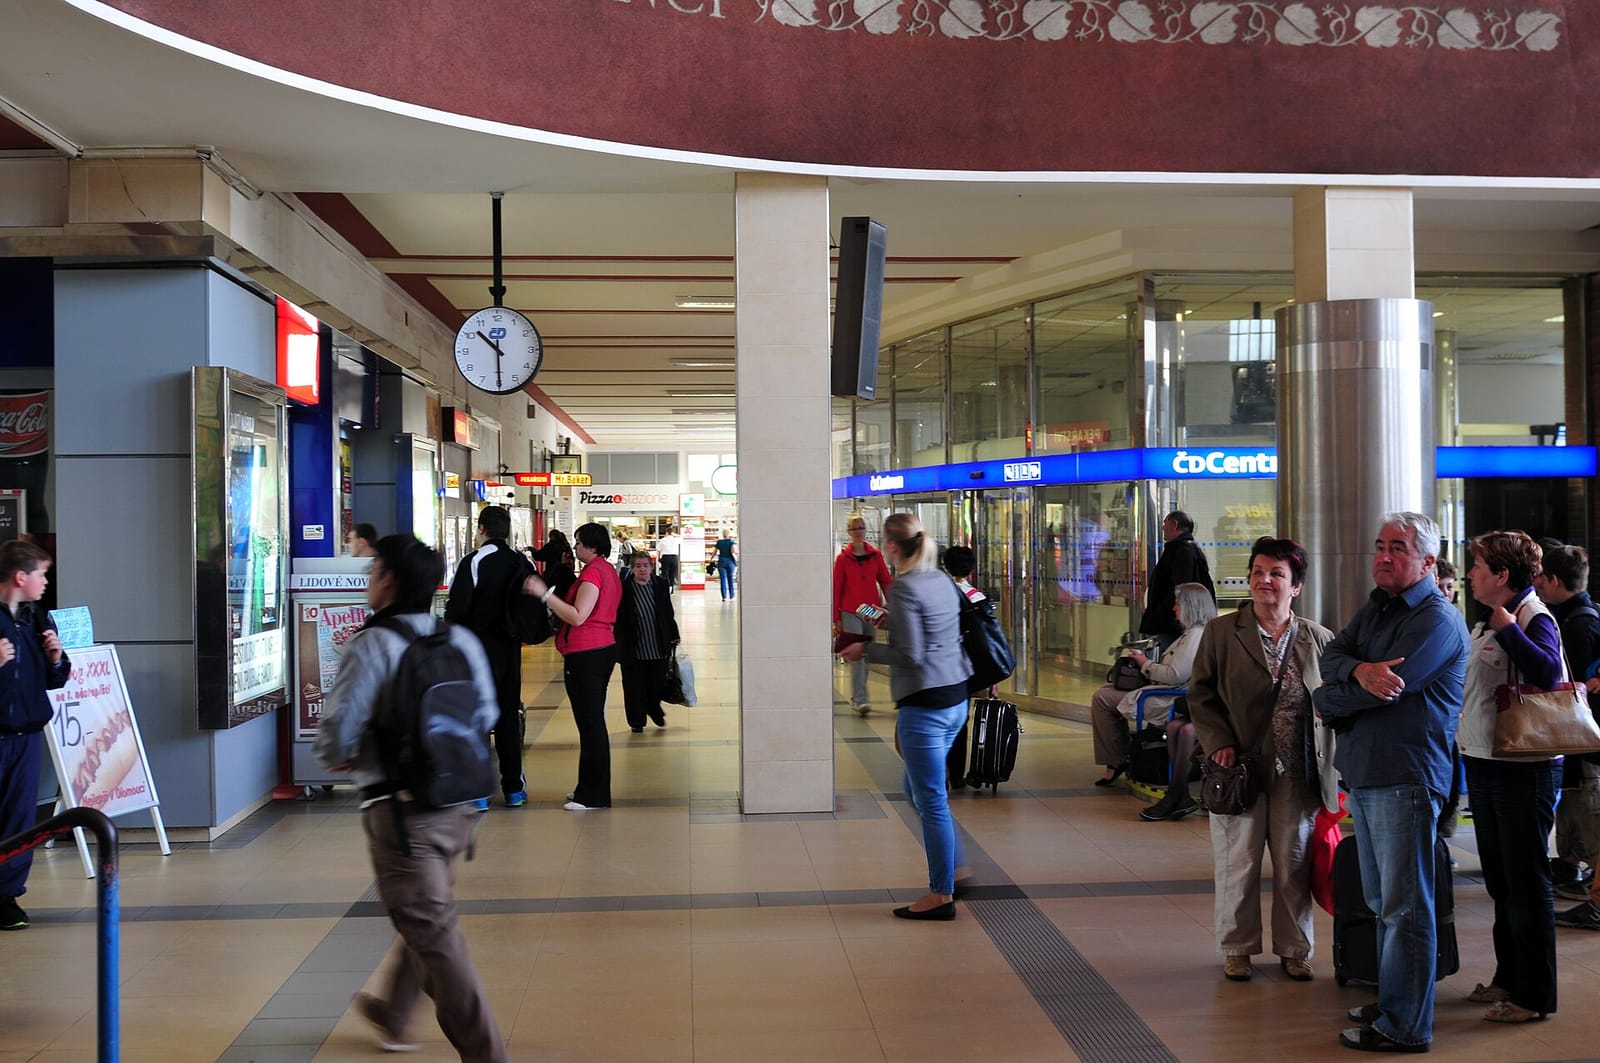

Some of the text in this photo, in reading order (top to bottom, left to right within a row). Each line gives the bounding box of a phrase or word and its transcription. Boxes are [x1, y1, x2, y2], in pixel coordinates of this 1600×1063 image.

[492, 314, 502, 322] 12
[511, 318, 517, 326] 1
[476, 319, 485, 327] 11
[464, 331, 476, 340] 10
[522, 329, 530, 338] 2
[462, 347, 469, 356] 9
[527, 345, 535, 354] 3
[466, 364, 474, 372] 8
[523, 362, 530, 370] 4
[479, 375, 486, 383] 7
[511, 374, 519, 382] 5
[579, 491, 613, 504] Pizza
[299, 576, 343, 587] LIDOVÉ
[87, 660, 111, 678] XXXL
